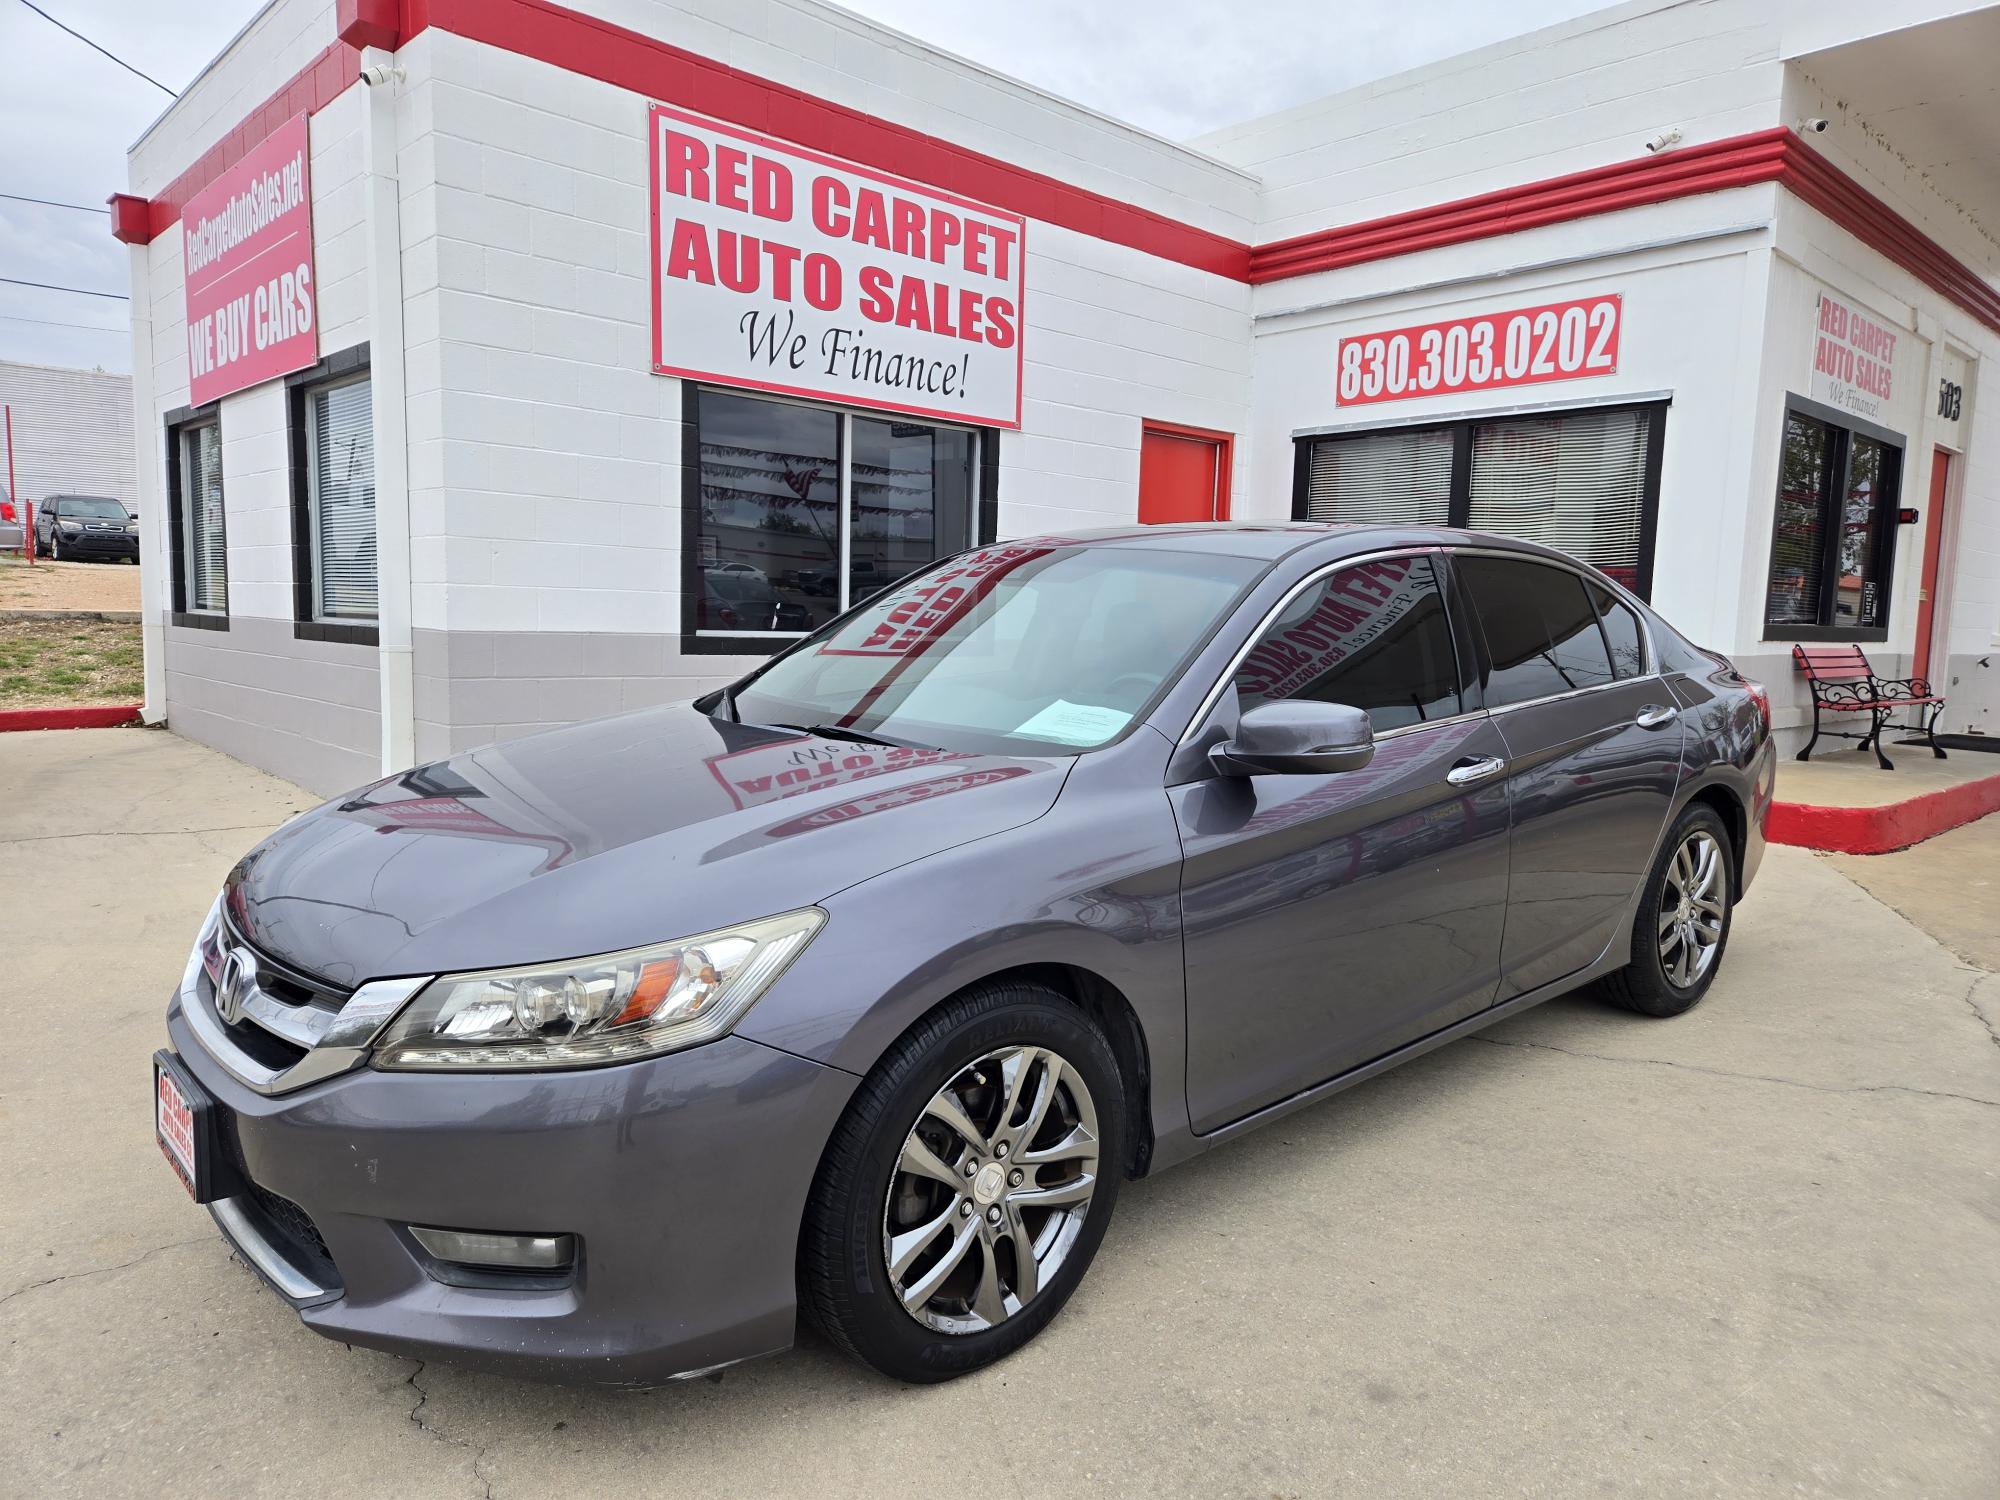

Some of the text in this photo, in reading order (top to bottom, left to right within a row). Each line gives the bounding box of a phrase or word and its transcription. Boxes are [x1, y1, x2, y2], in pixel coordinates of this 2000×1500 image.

[187, 150, 304, 276] RedCarpetAutoSales.net
[665, 128, 1017, 281] RED CARPET
[188, 263, 312, 379] WE BUY CARS
[666, 217, 1015, 348] AUTO SALES
[739, 308, 970, 400] We Finance!
[1340, 302, 1617, 399] 830.303.0202
[1815, 336, 1892, 400] AUTO SALES
[1819, 296, 1897, 364] RED CARPET
[1828, 381, 1879, 418] We Finance!
[1937, 378, 1962, 422] 503
[159, 1075, 172, 1111] RED
